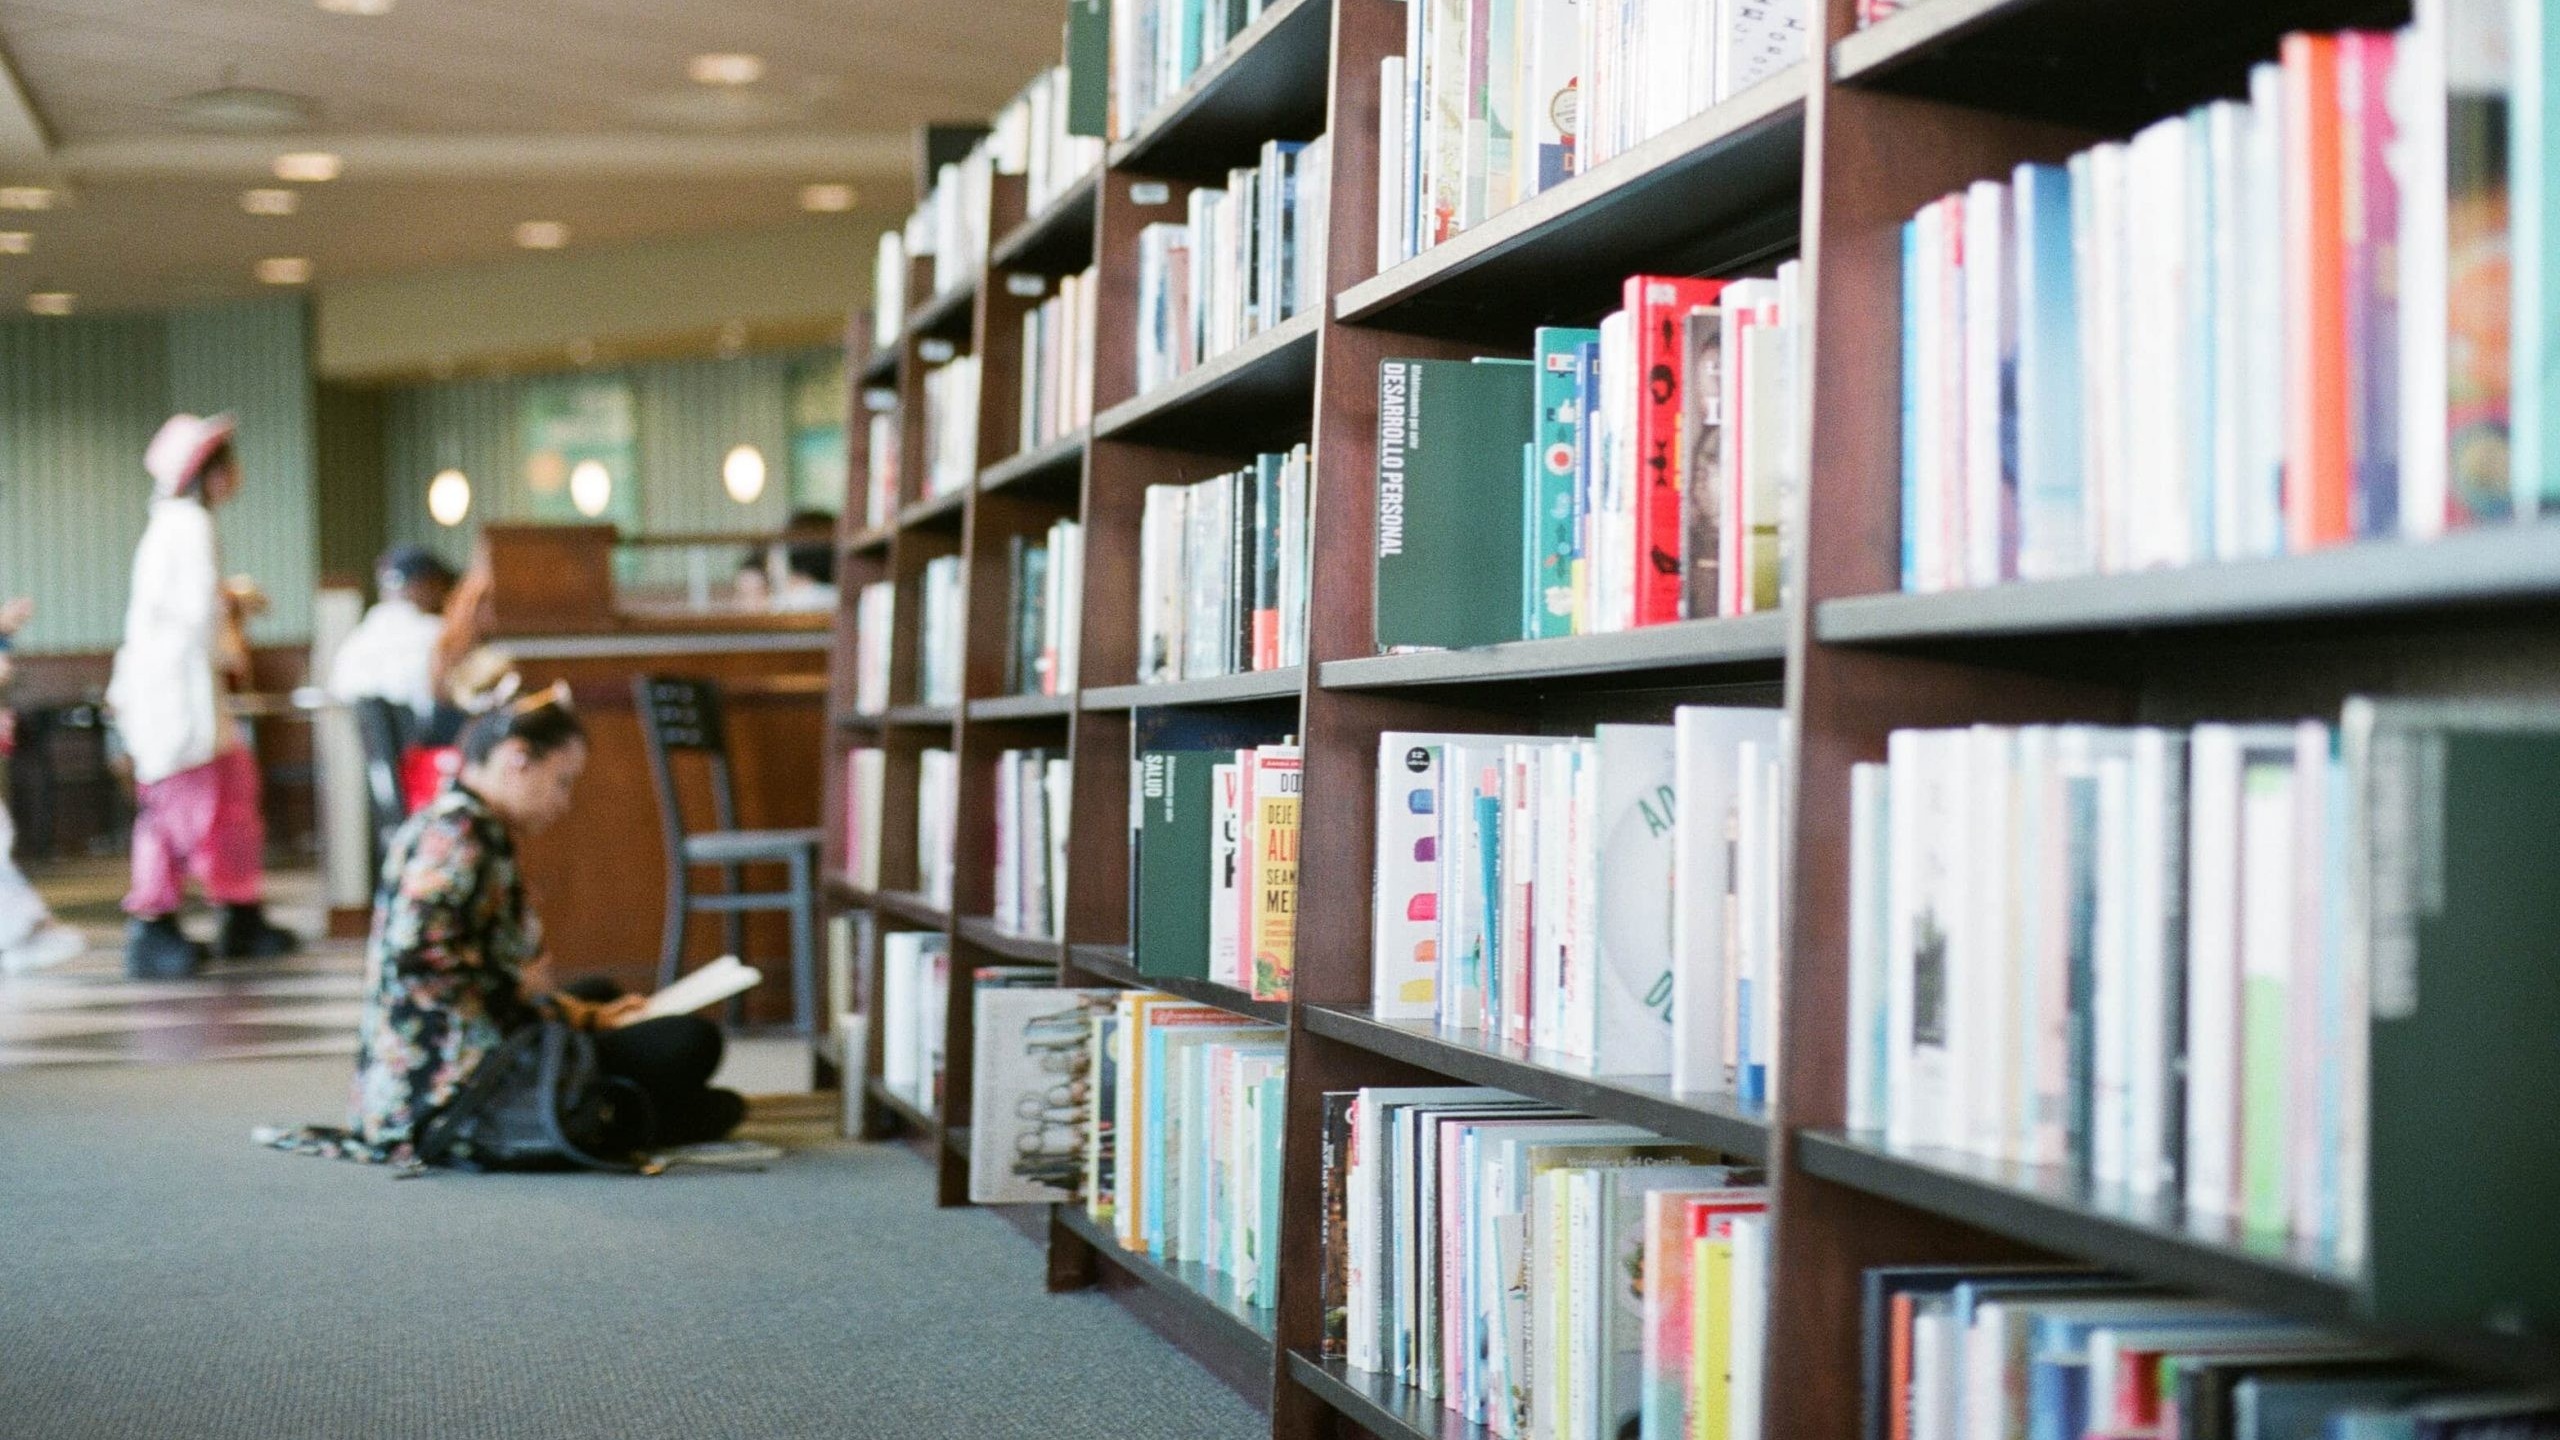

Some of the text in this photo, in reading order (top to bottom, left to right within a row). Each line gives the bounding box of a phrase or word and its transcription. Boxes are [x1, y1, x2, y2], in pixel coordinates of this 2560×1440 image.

[1380, 362, 1405, 557] DESARROLLO PERSONAL
[1145, 755, 1162, 798] SALUD
[1267, 804, 1292, 825] DEJE
